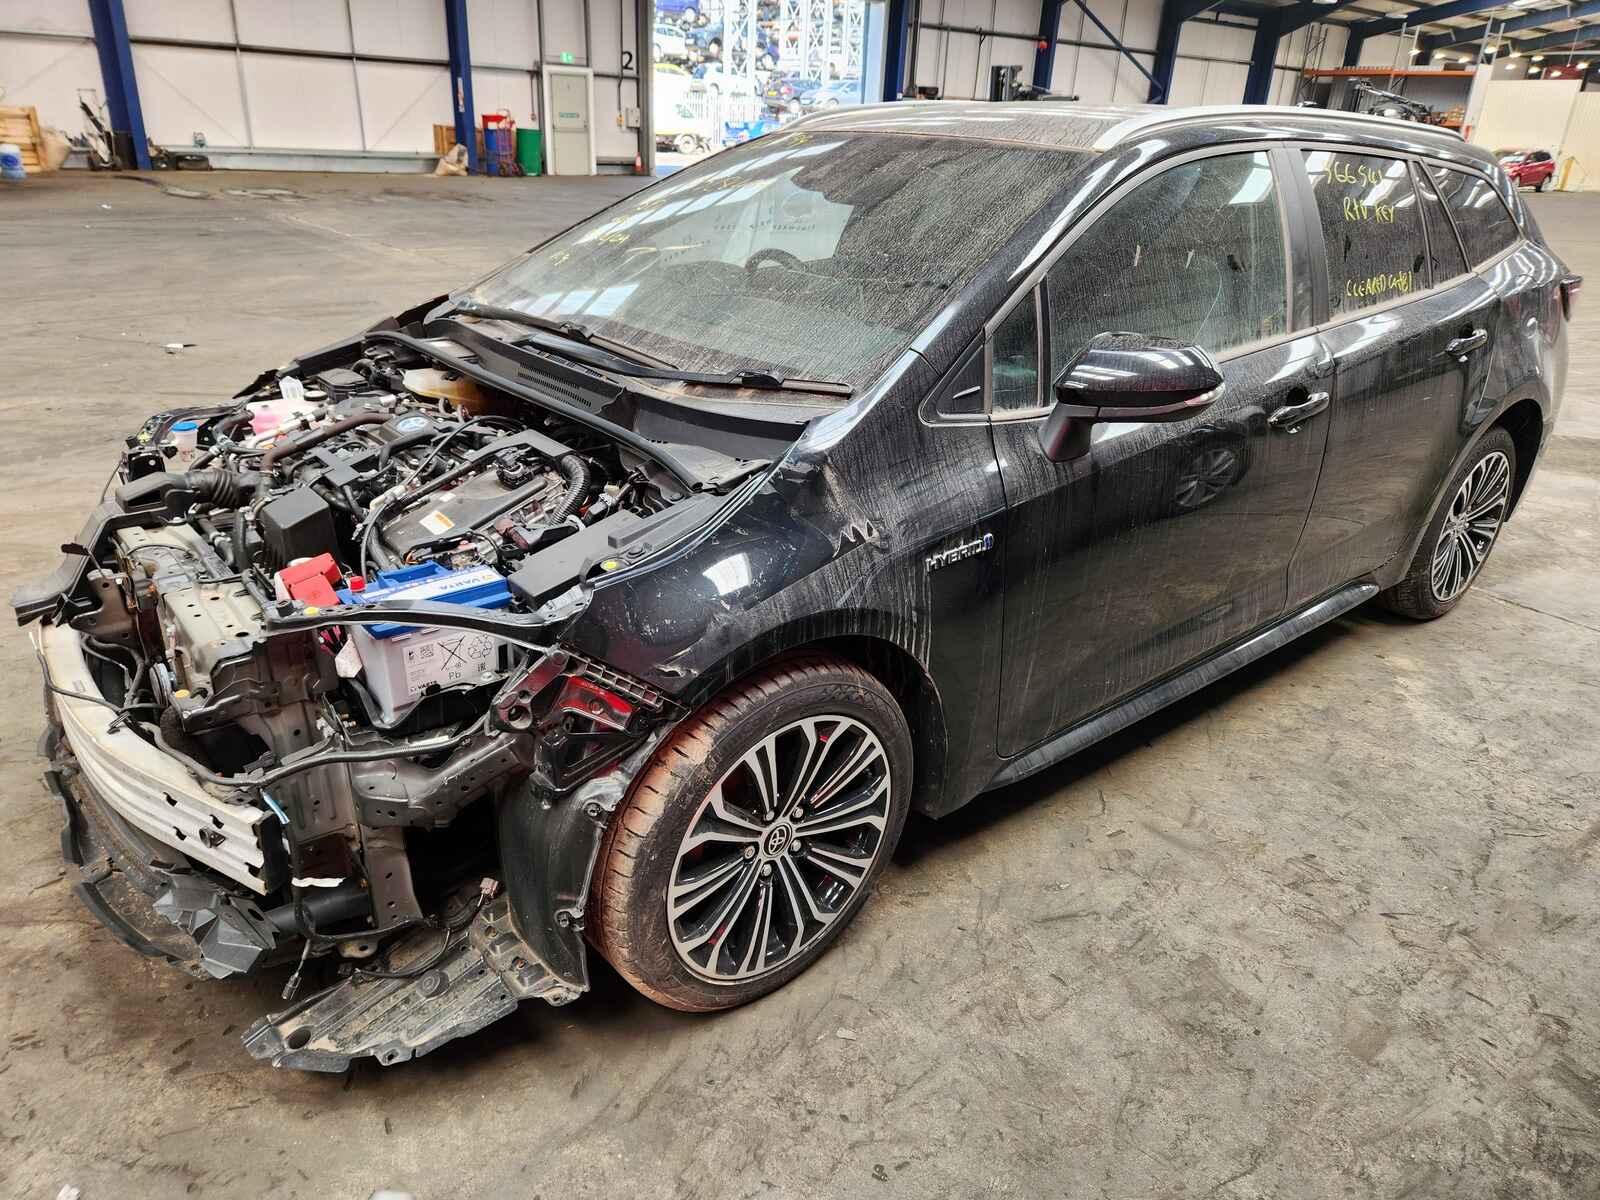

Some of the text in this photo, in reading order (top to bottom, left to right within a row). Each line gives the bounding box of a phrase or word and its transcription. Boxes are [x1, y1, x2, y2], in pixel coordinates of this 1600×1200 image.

[621, 50, 634, 70] 2
[925, 538, 984, 572] HYBRID
[448, 671, 461, 680] Pb
